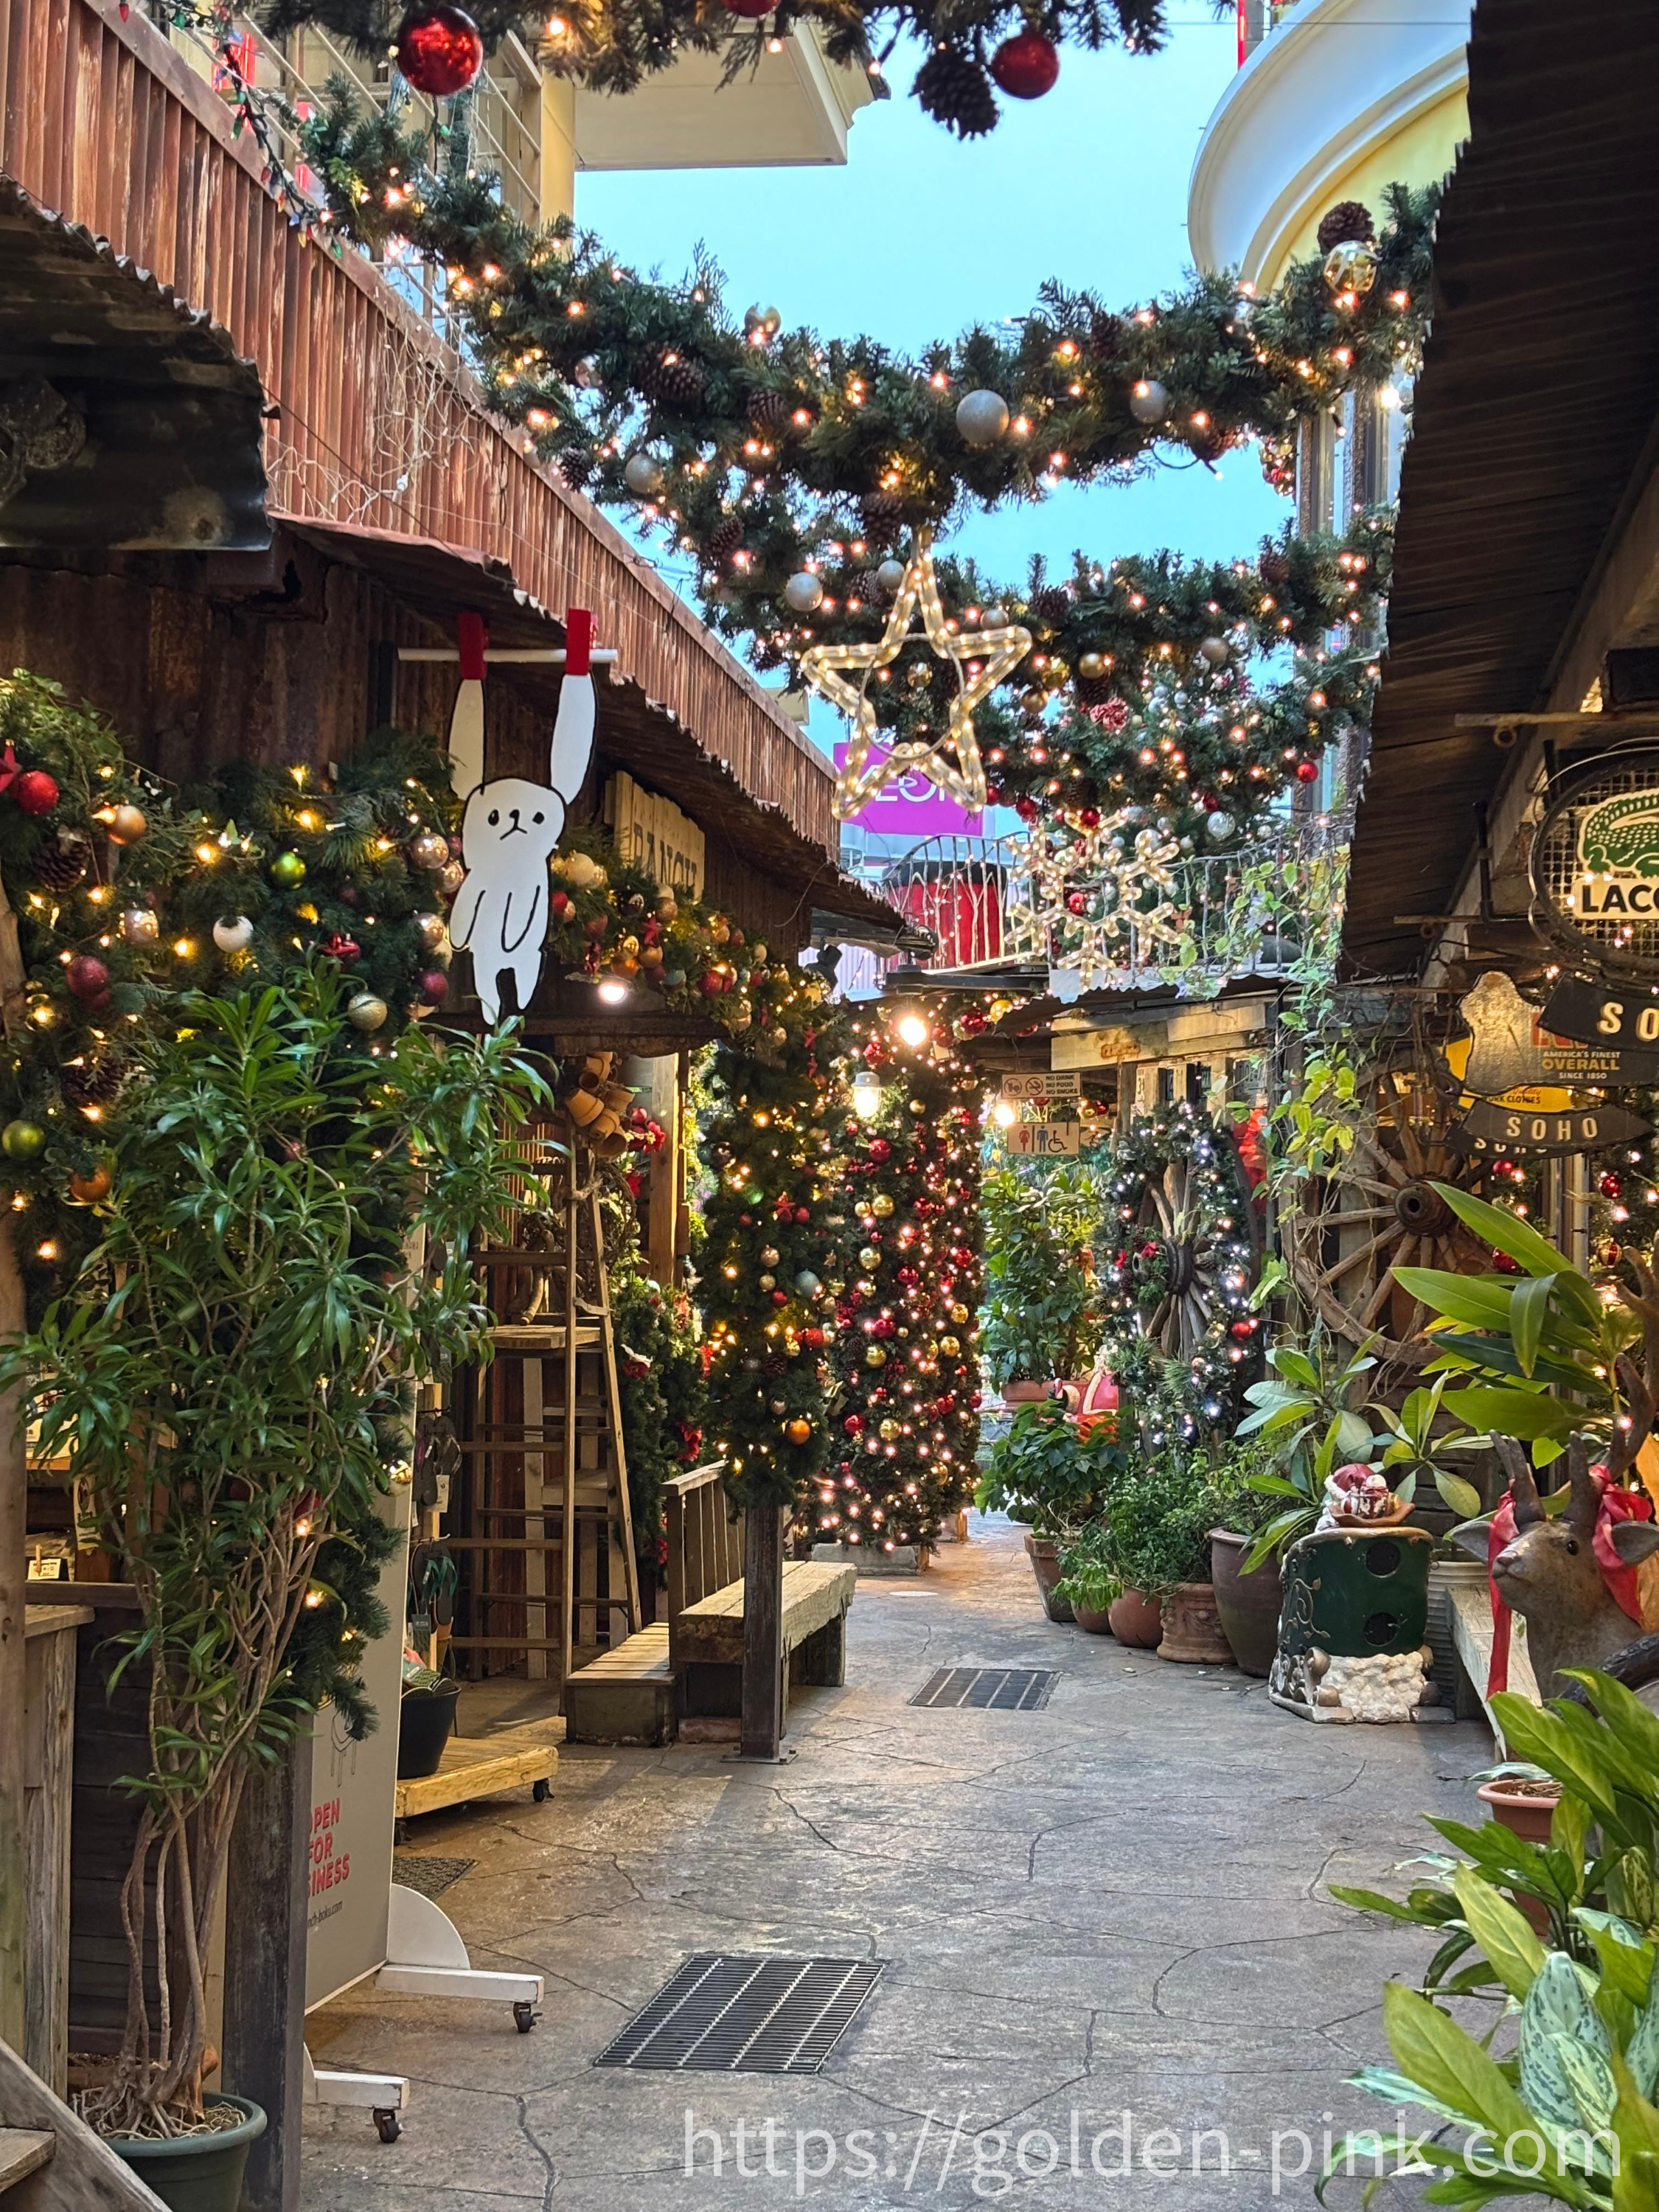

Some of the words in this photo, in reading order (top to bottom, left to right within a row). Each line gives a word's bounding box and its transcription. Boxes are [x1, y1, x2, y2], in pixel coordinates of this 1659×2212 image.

[1582, 883, 1659, 914] LAC
[1543, 1051, 1589, 1059] AMERICA'S
[1541, 1059, 1621, 1071] OVERALL
[1506, 1116, 1598, 1141] SOHO
